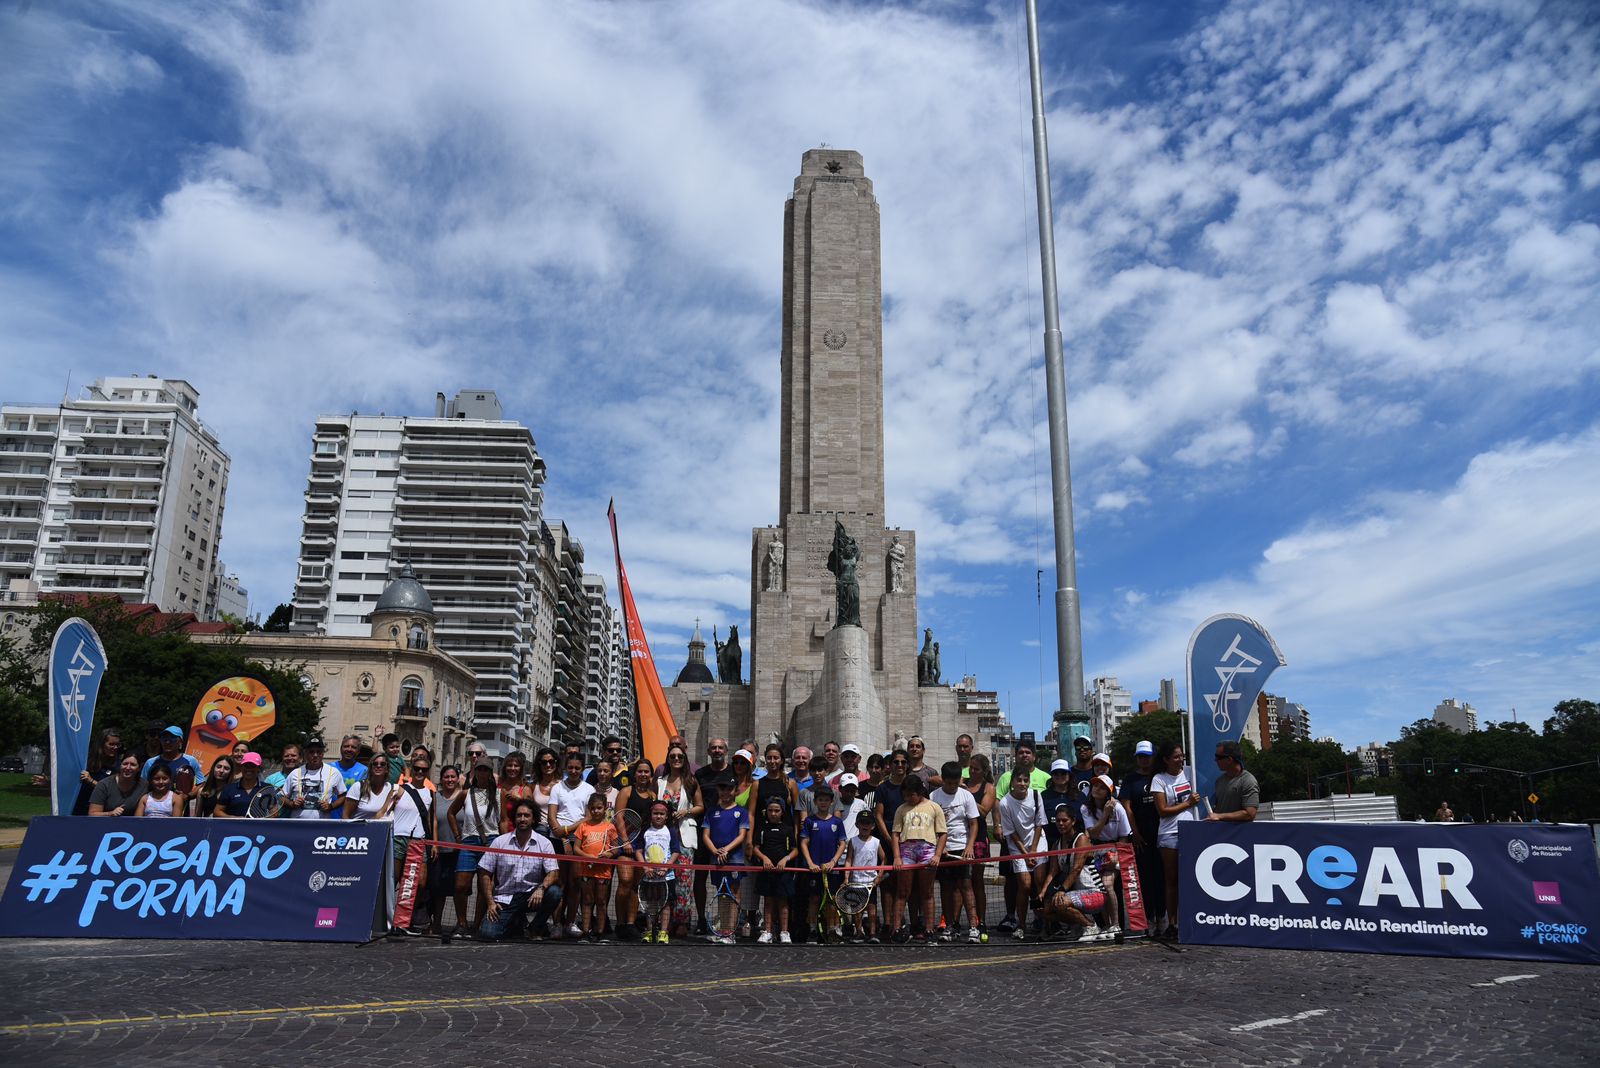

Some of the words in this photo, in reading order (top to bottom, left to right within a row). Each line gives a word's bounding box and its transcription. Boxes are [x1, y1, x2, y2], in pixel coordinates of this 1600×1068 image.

[217, 686, 256, 704] Quini
[256, 695, 267, 707] 6
[78, 877, 246, 927] FORMA
[1195, 912, 1247, 927] Centro
[1250, 914, 1317, 930] Regional
[1320, 917, 1341, 930] de
[1344, 917, 1378, 932] Alto
[1380, 919, 1488, 936] Rendimiento
[1538, 932, 1580, 944] FORMA
